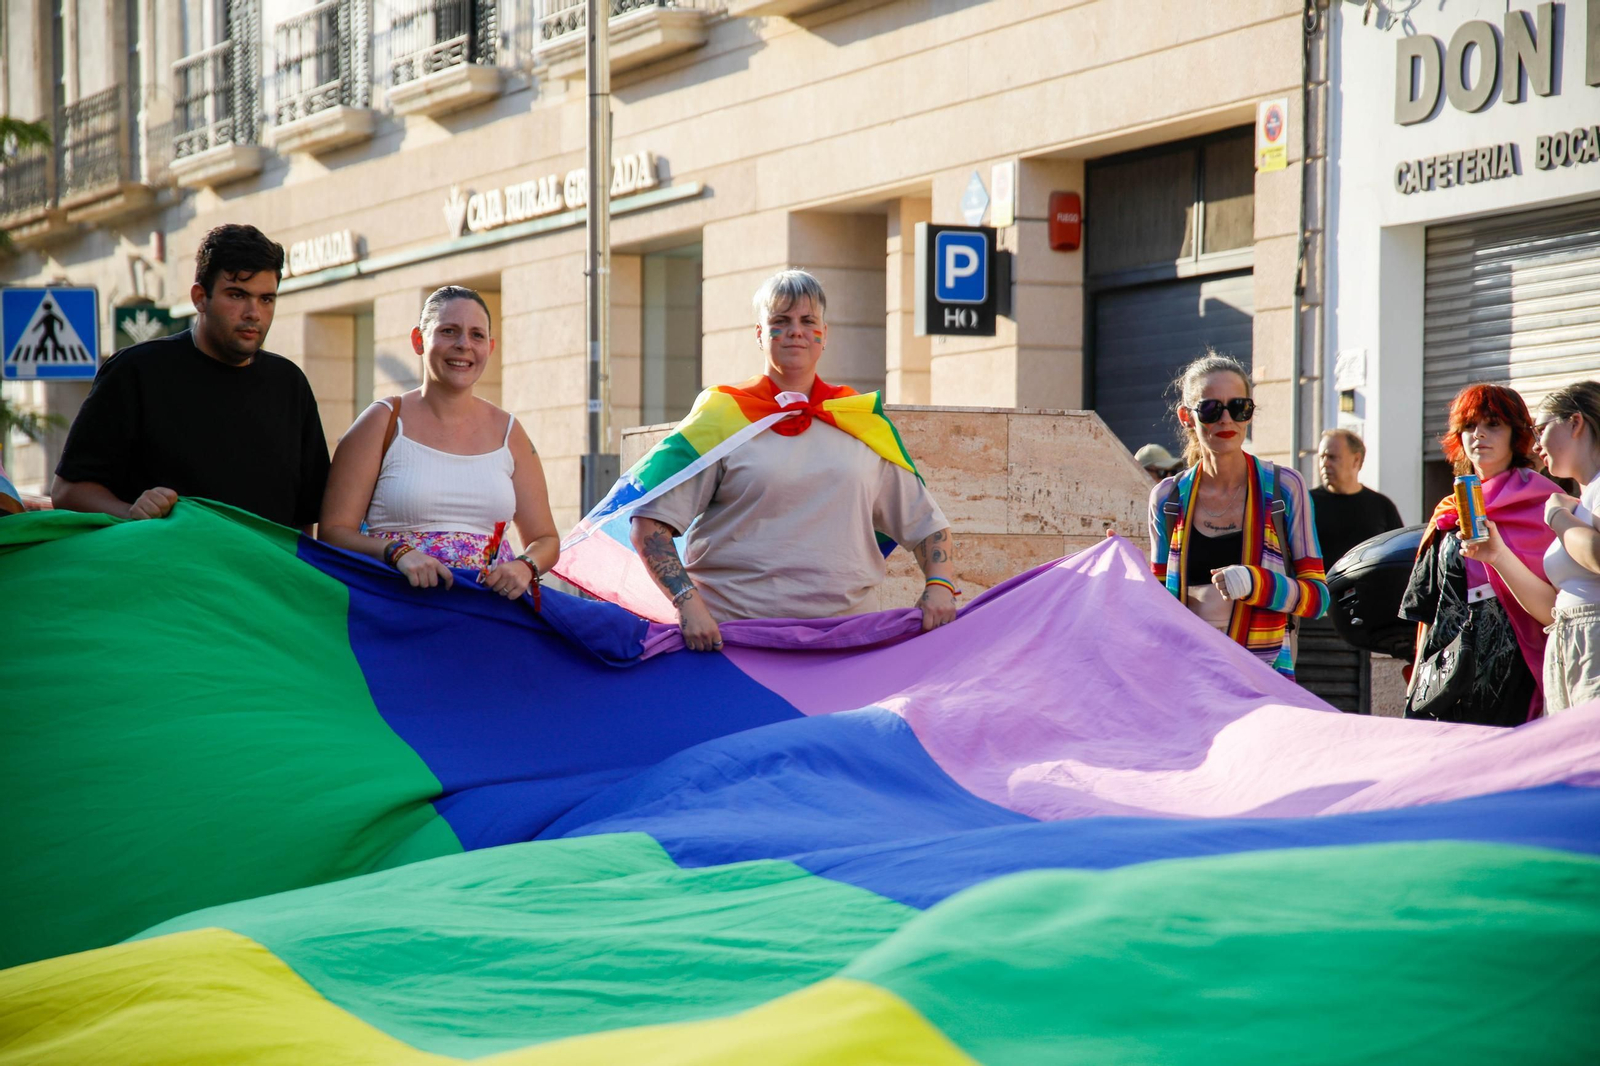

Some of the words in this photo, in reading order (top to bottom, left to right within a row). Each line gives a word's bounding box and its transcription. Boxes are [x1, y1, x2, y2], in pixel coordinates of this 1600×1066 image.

[1394, 2, 1554, 126] DON
[1394, 143, 1516, 194] CAFETERIA
[504, 174, 562, 222] RURAL
[1057, 213, 1079, 222] FUEGO
[289, 228, 355, 277] GRANADA
[945, 244, 979, 289] P
